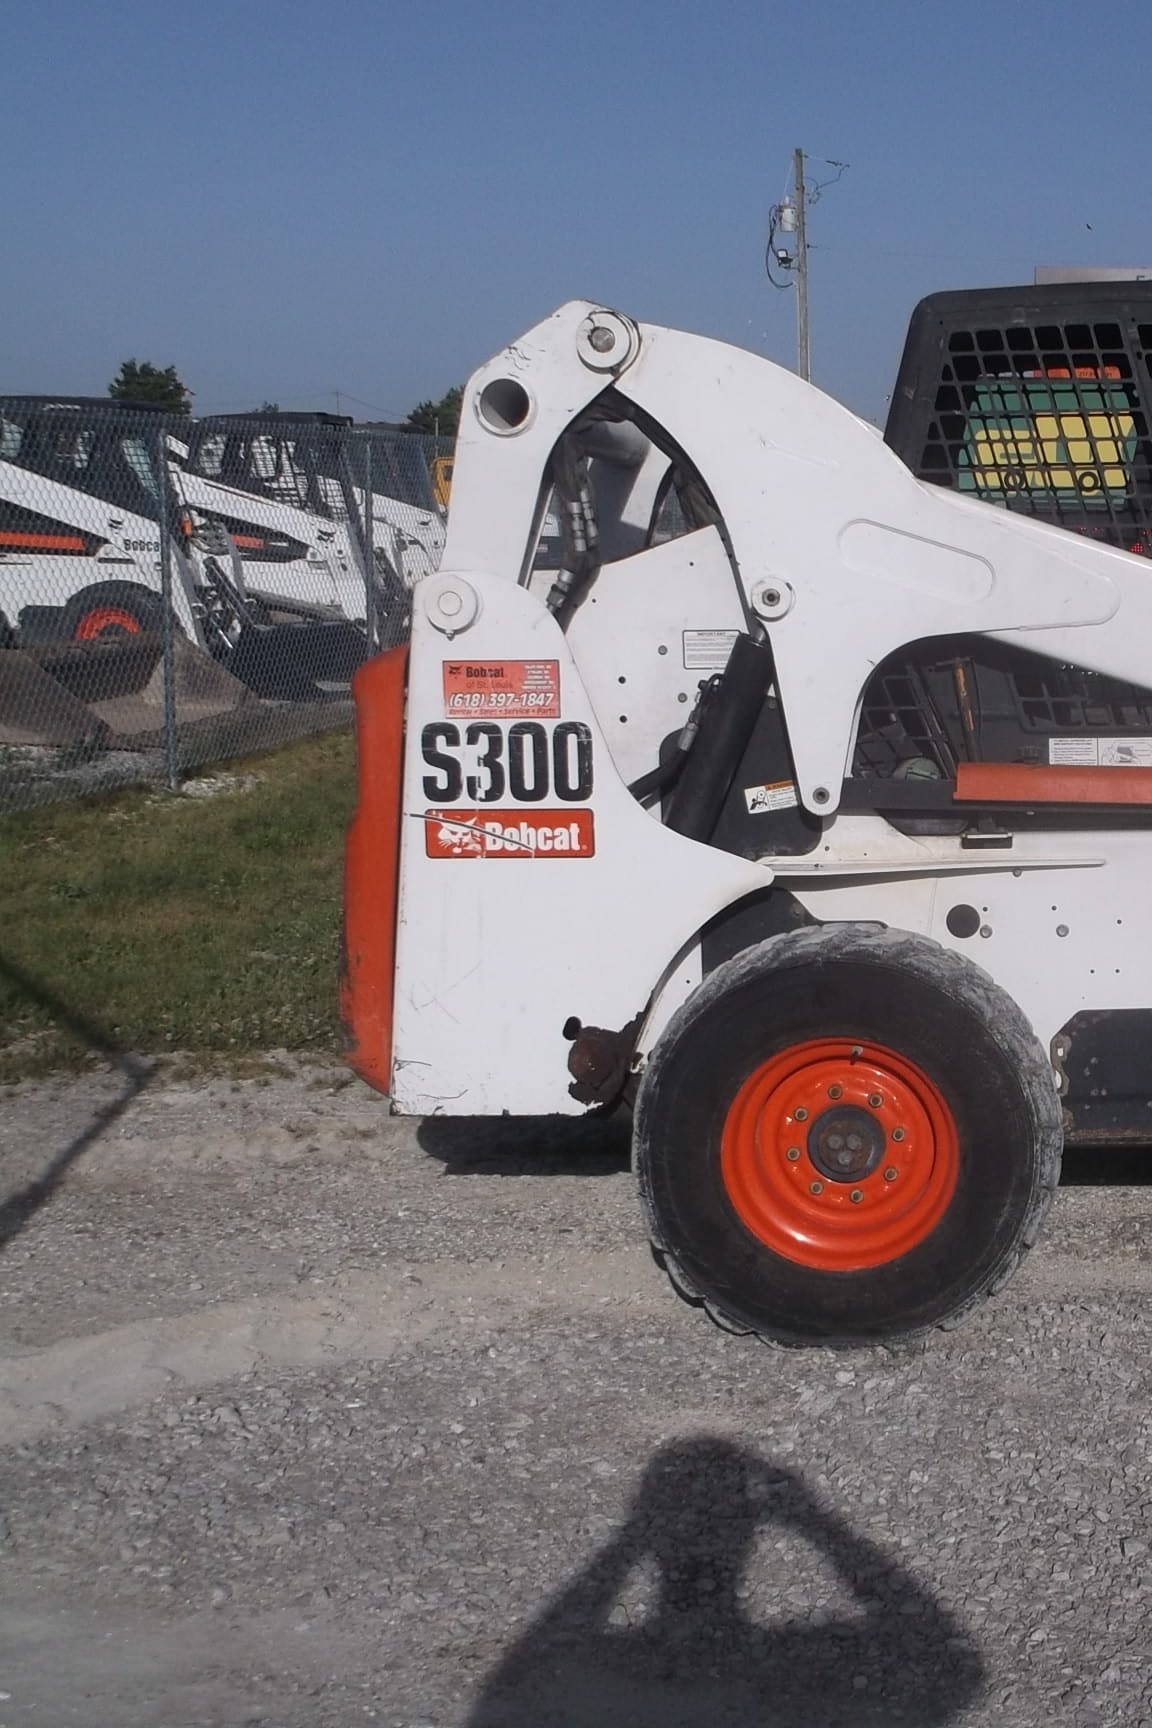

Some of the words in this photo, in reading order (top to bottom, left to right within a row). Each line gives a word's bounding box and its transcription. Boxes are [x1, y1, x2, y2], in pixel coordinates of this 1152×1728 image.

[124, 539, 161, 552] Bobca
[466, 666, 504, 678] Bobcat
[449, 693, 485, 707] (618)
[488, 693, 555, 707] 397-1847
[421, 721, 594, 803] S300
[485, 821, 581, 851] Bobcat
